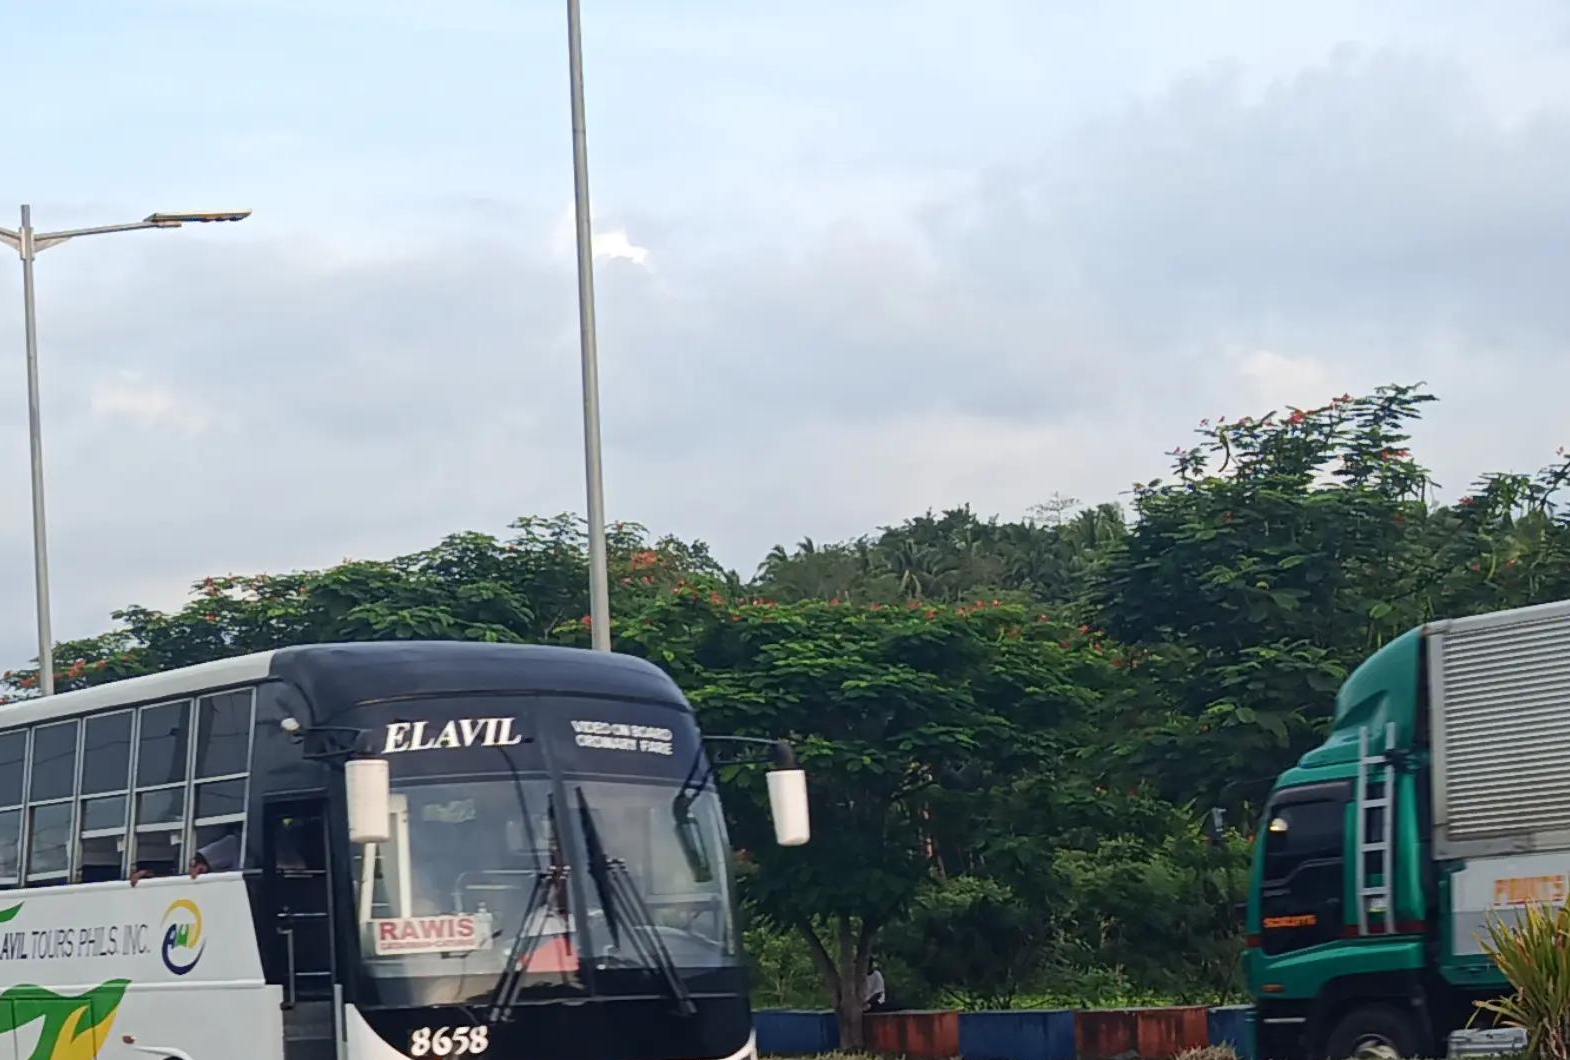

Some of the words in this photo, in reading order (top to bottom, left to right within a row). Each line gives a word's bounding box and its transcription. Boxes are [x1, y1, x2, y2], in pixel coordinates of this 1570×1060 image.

[380, 717, 523, 755] ELAVIL
[31, 928, 74, 959] TOURS
[379, 917, 474, 941] RAWIS
[410, 1025, 489, 1056] 8658
